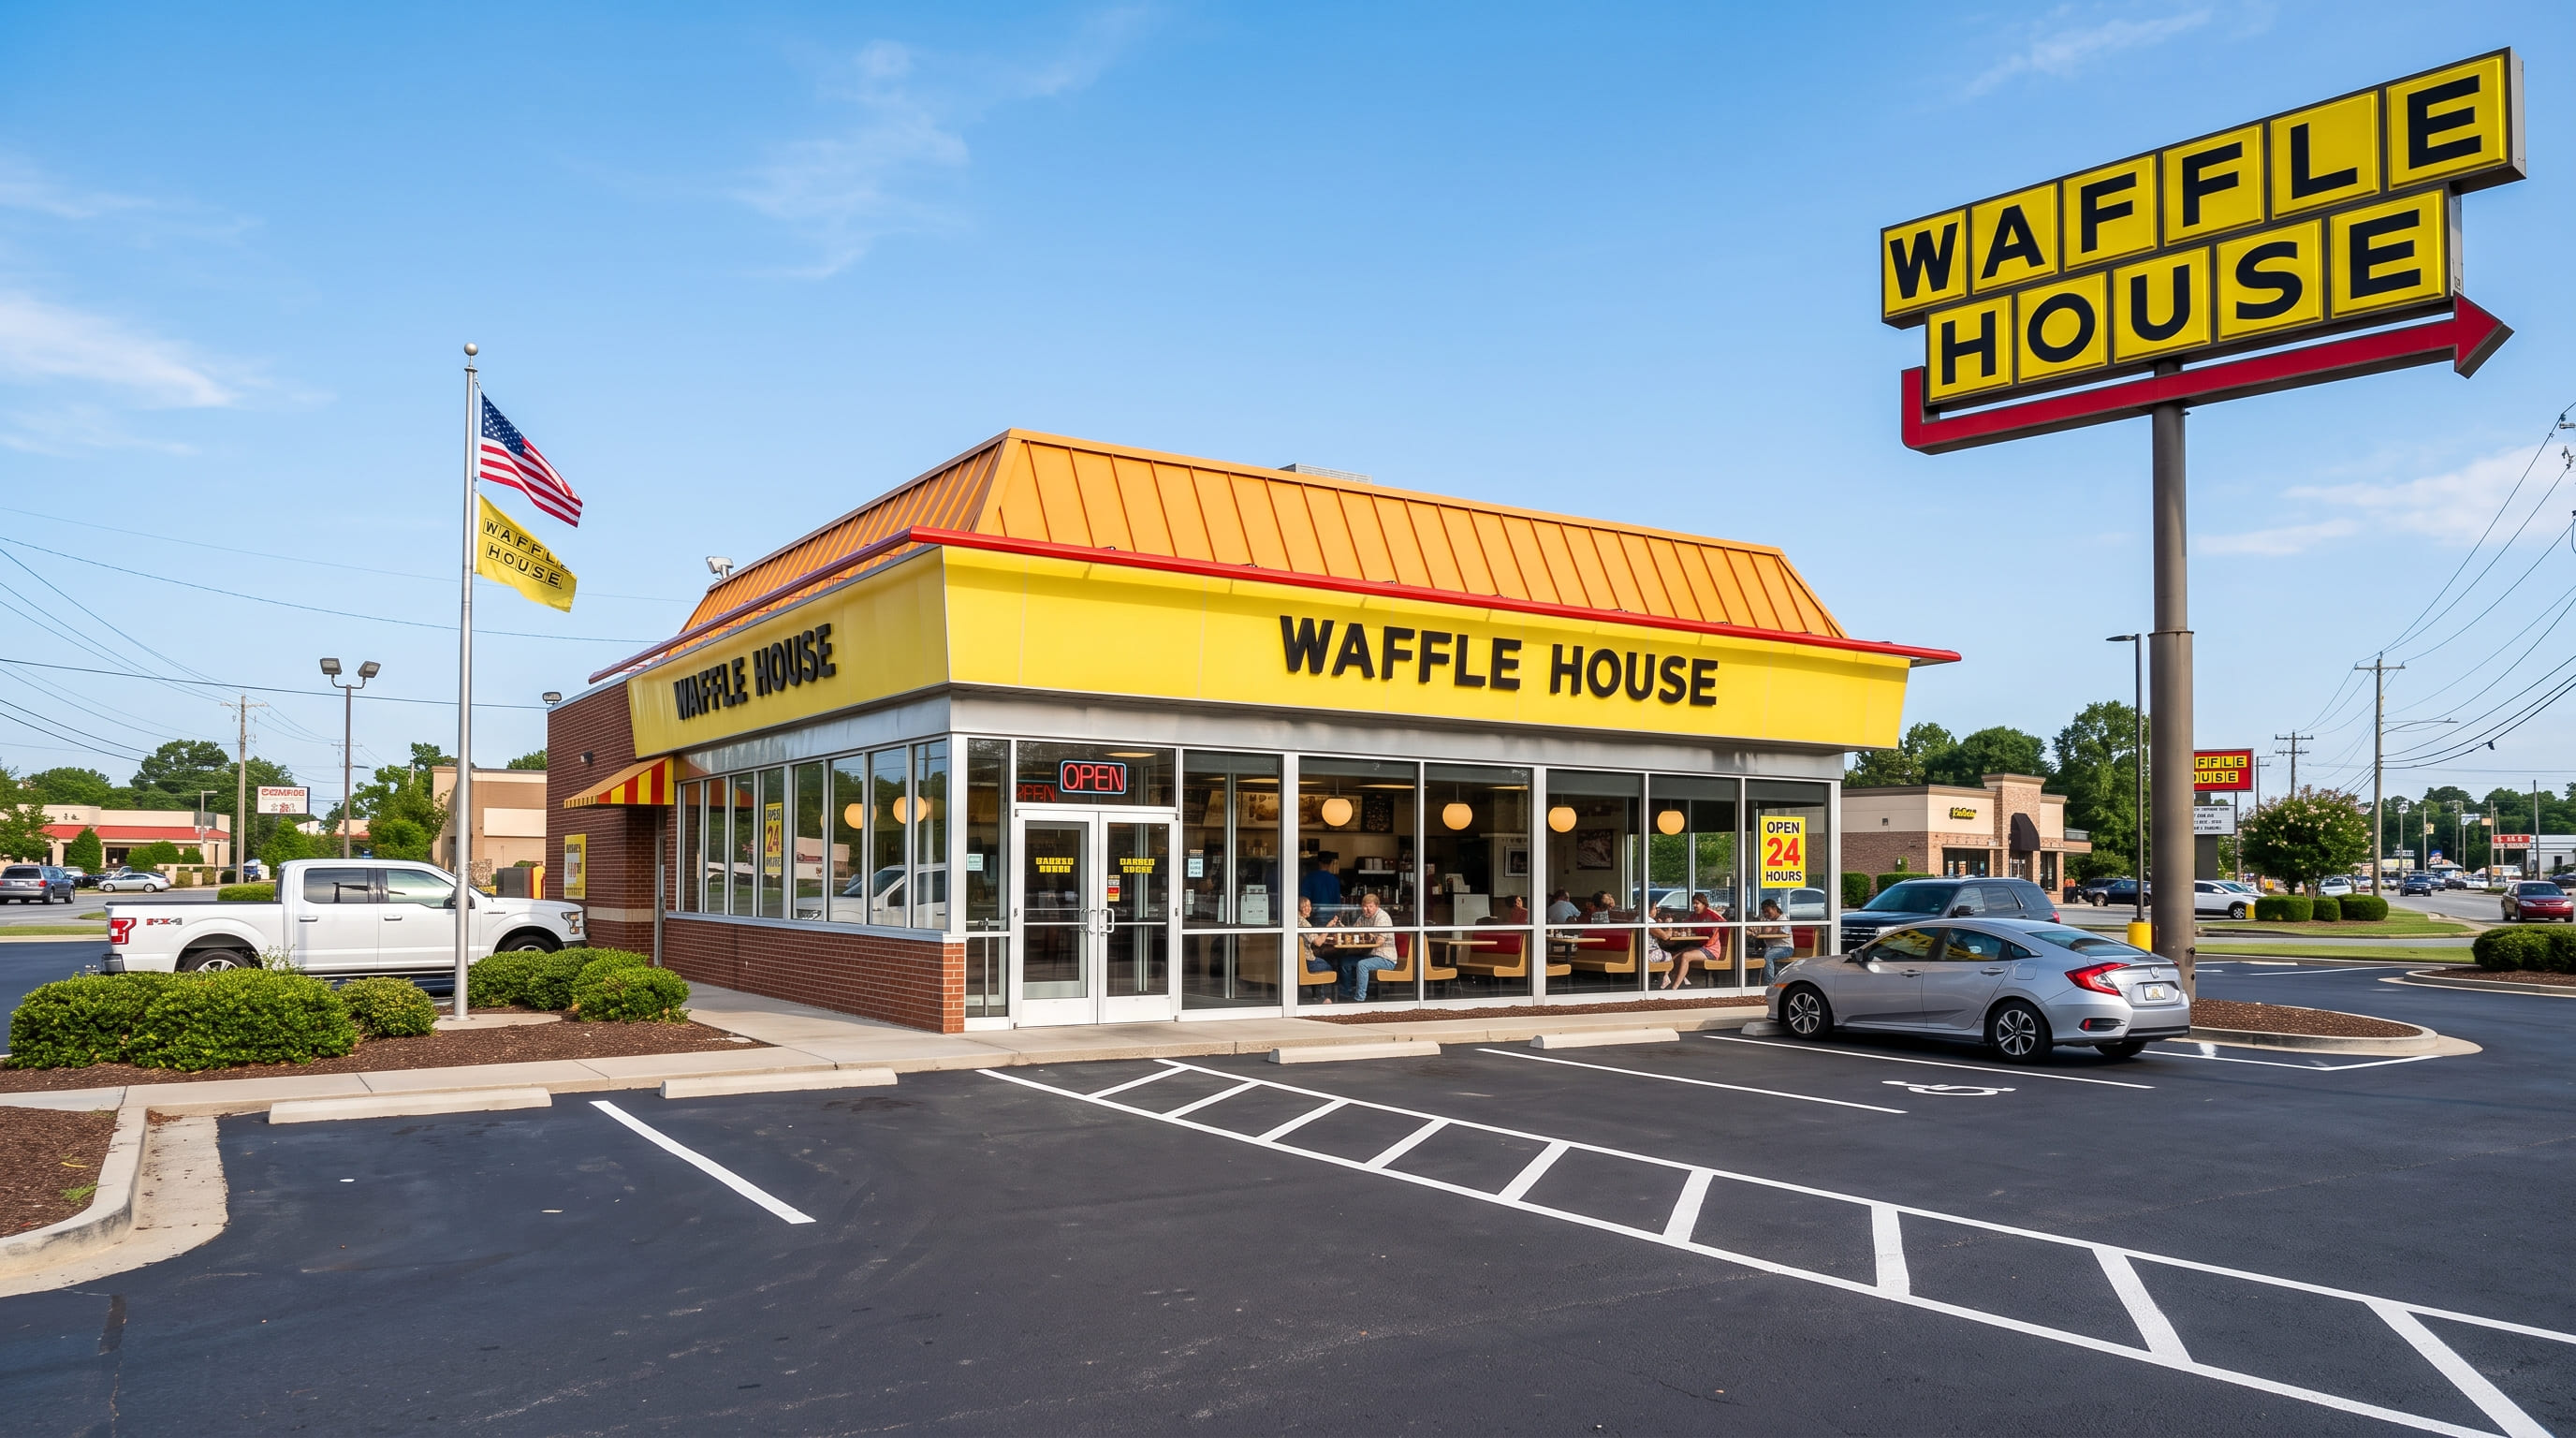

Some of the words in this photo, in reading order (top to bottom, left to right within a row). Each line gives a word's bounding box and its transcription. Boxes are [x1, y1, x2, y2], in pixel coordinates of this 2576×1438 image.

[1889, 74, 2482, 300] WAFFLE
[1940, 209, 2422, 386] HOUSE
[488, 544, 562, 587] HOUSE
[673, 656, 748, 720] WAFFLE
[752, 623, 836, 697] HOUSE
[1280, 615, 1522, 690] WAFFLE
[1550, 643, 1719, 706] HOUSE
[2197, 756, 2245, 768] FFLE
[1062, 763, 1124, 792] OPEN
[2194, 772, 2237, 783] USE
[767, 825, 780, 852] 24
[1766, 821, 1800, 834] OPEN
[1766, 837, 1801, 867] 24
[1765, 871, 1802, 881] HOURS
